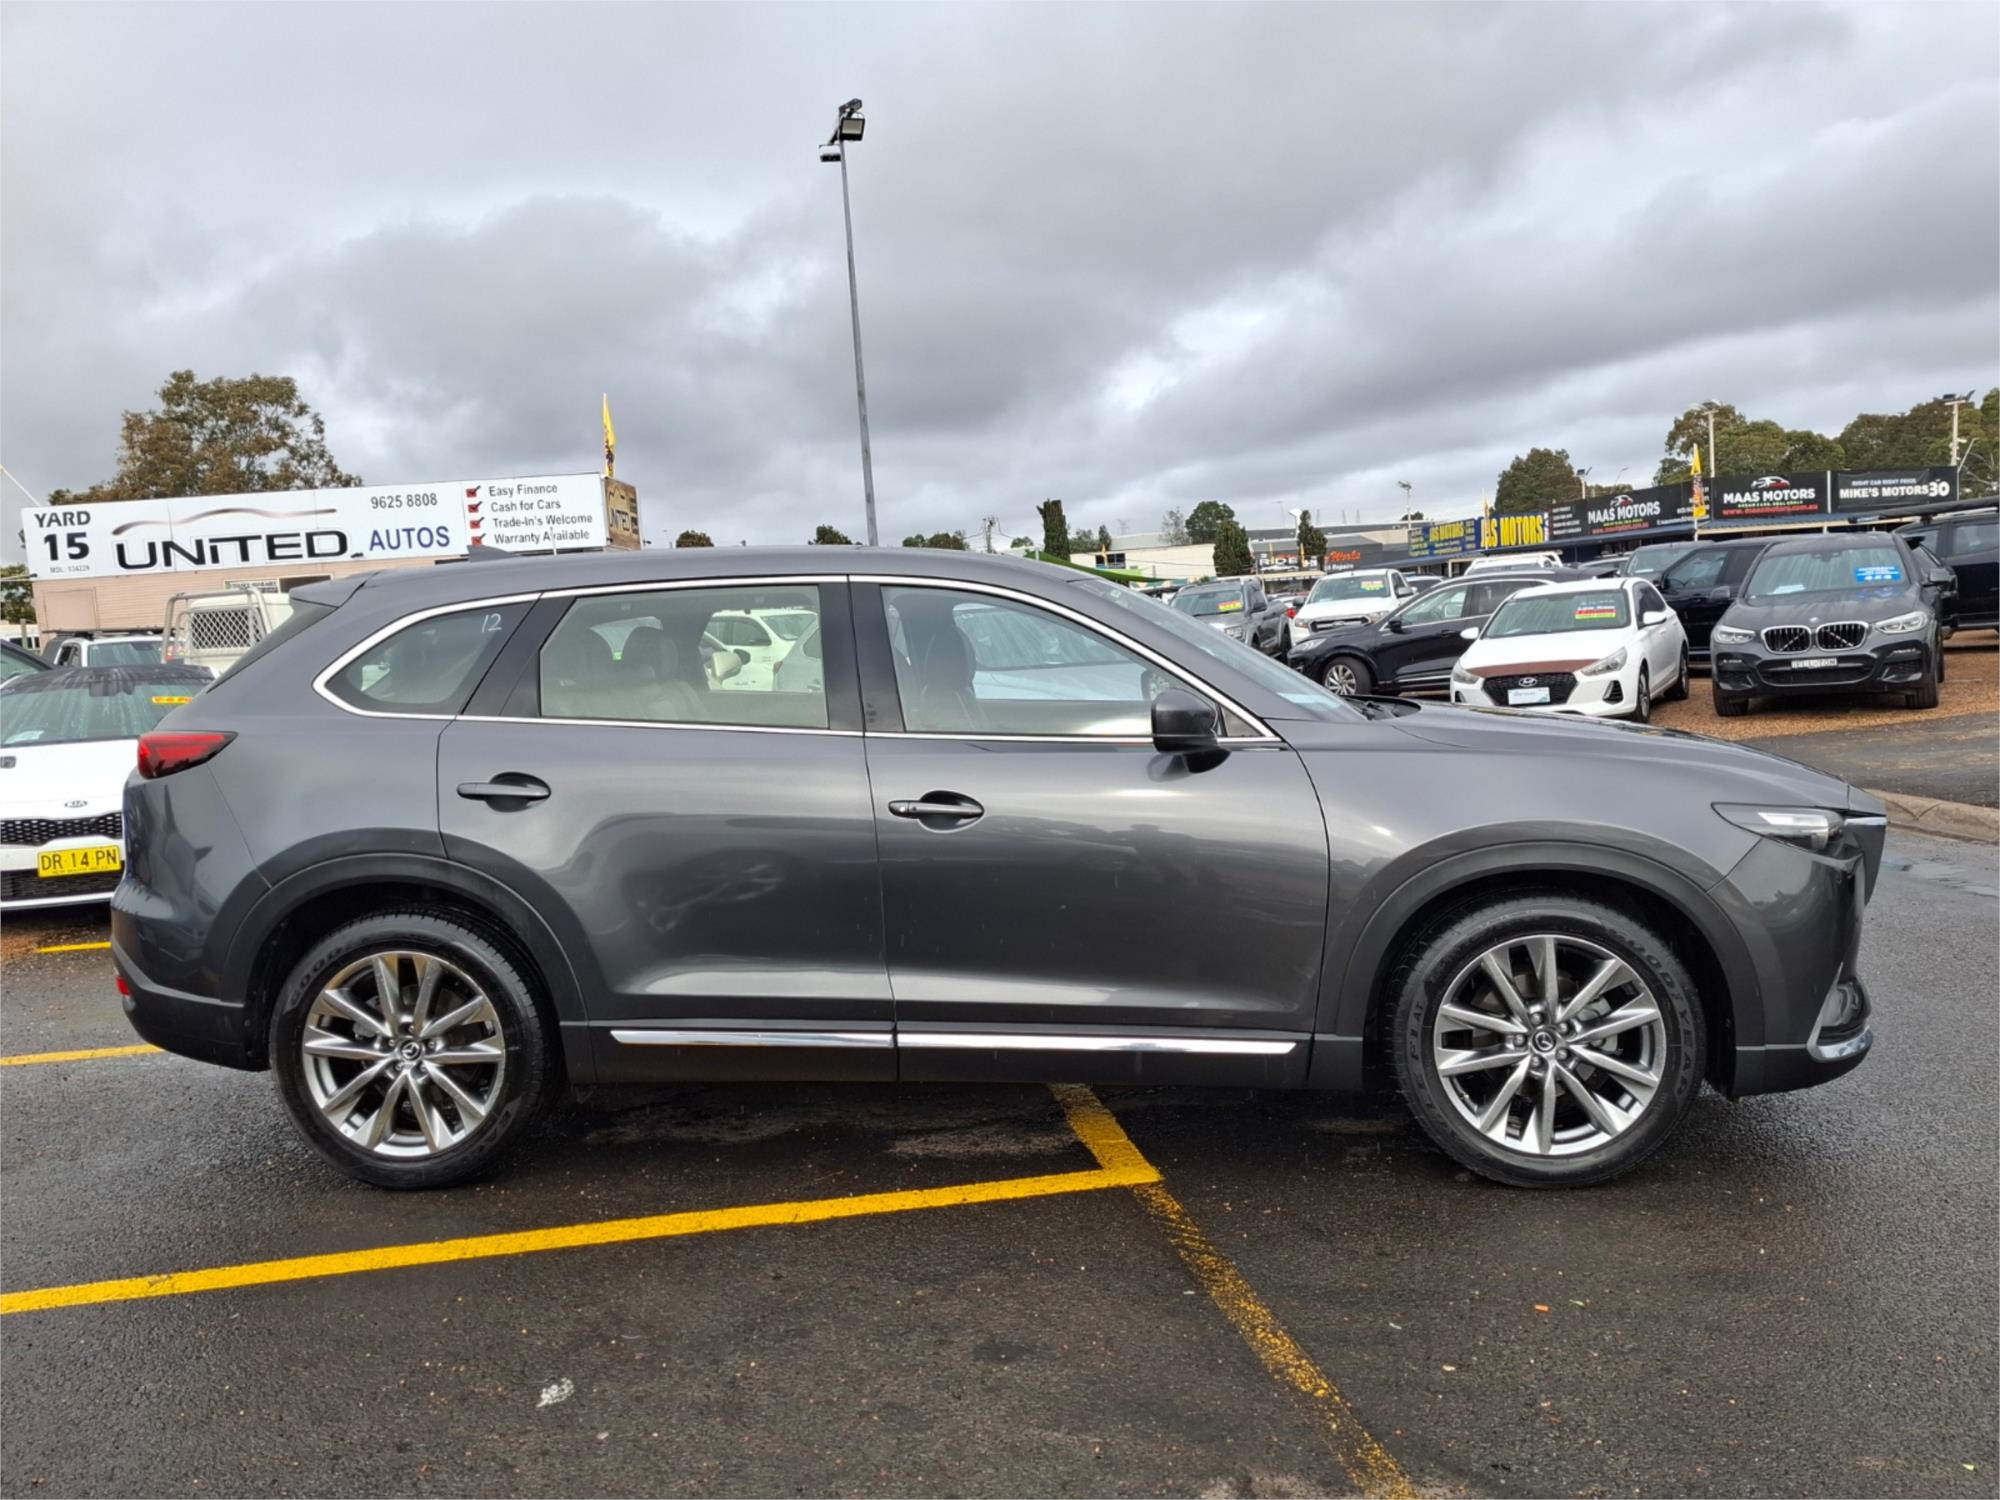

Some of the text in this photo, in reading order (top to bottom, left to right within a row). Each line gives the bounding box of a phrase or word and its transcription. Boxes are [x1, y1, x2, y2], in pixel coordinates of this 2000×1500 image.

[488, 483, 558, 498] Easy Finance
[1723, 488, 1816, 504] MAAS MOTORS
[1839, 481, 1950, 499] MIKE'S MOTORS 30
[371, 492, 438, 510] 9625 8808
[490, 498, 561, 513] Cash for Cars
[34, 510, 91, 528] YARD
[492, 513, 593, 528] Trade-In's Welcome
[1587, 508, 1616, 524] MAAS
[1617, 501, 1661, 519] MOTORS
[369, 526, 450, 551] AUTOS
[494, 530, 540, 545] Warranty
[1501, 514, 1545, 546] MOTORS
[43, 531, 90, 561] 15
[116, 531, 349, 569] UNITED
[481, 612, 503, 633] 12
[40, 853, 63, 871] DR
[70, 851, 90, 868] 14
[95, 847, 117, 866] PN
